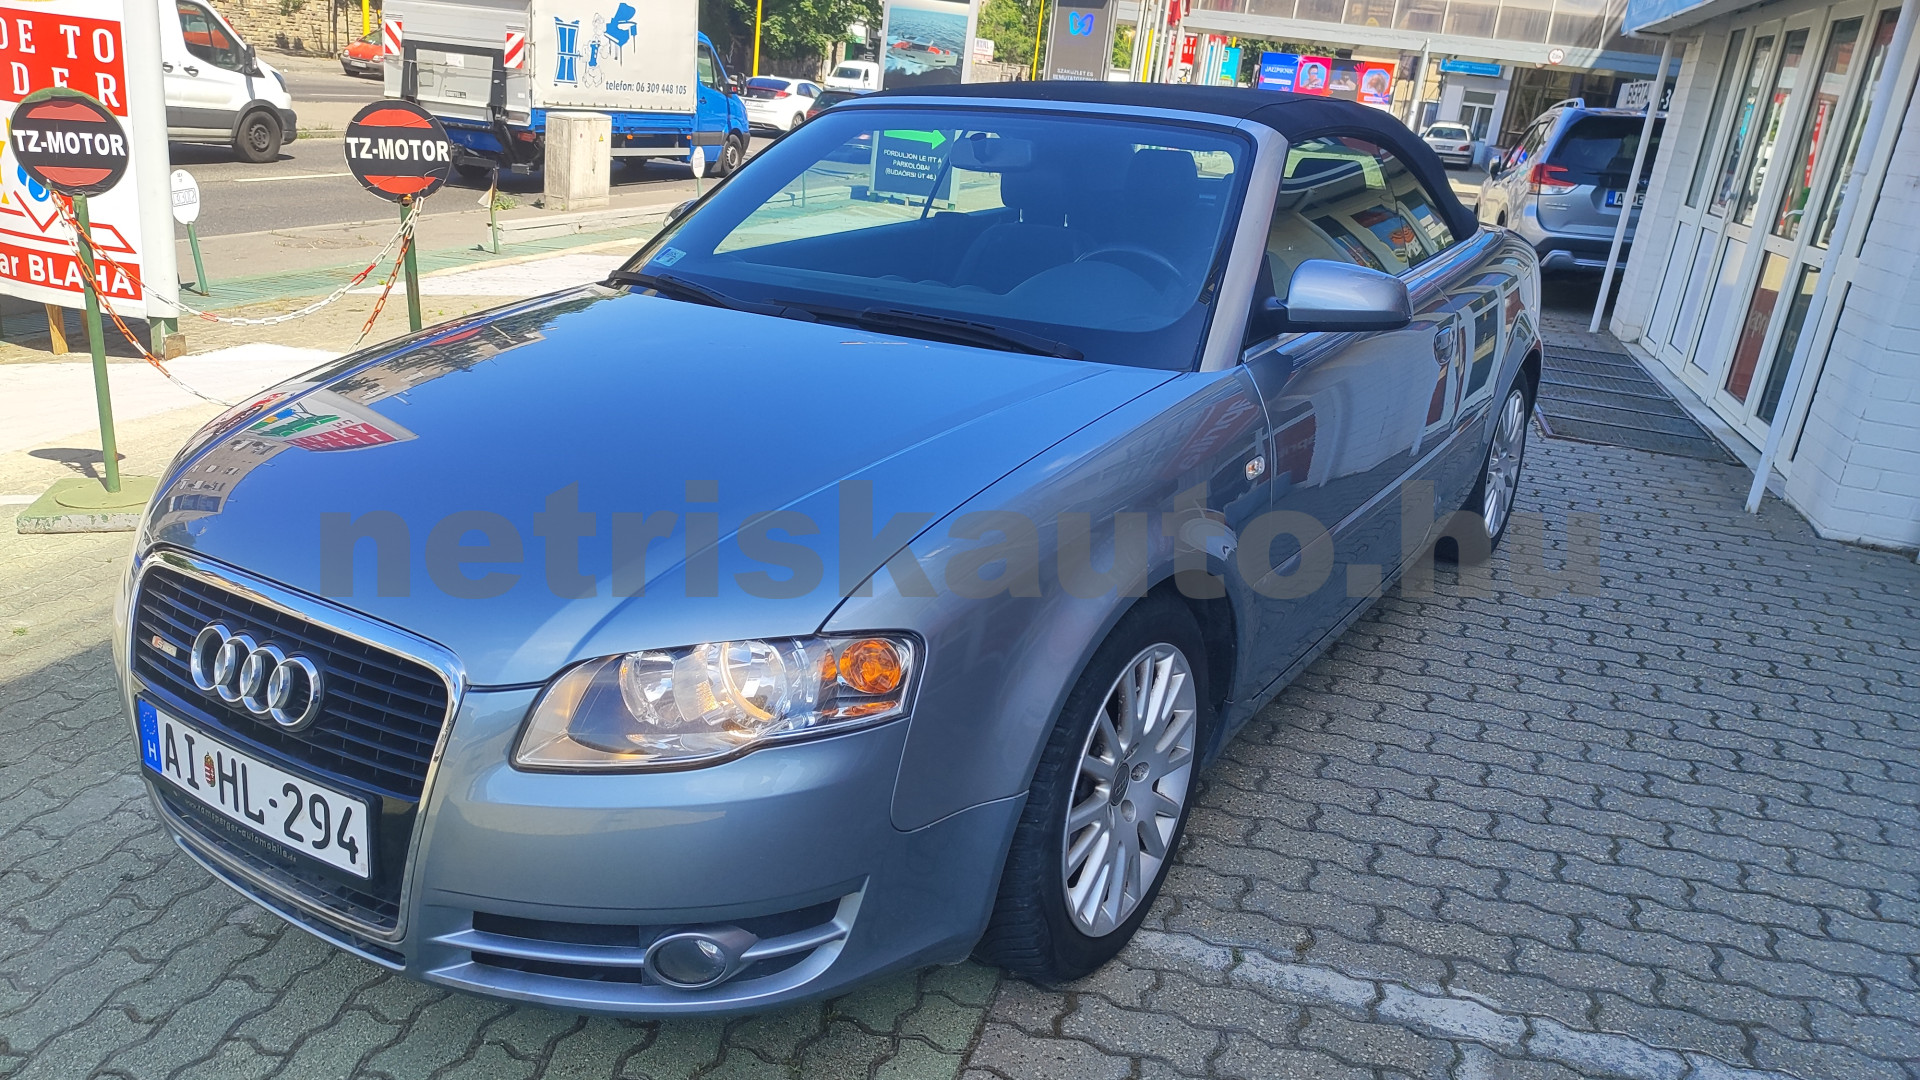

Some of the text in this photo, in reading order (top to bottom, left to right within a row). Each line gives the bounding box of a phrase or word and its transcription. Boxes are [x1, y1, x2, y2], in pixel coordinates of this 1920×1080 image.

[59, 24, 115, 63] TO
[10, 61, 120, 107] DER
[606, 80, 687, 95] telefon: 06 309 448 105
[12, 129, 126, 157] TZ-MOTOR
[346, 137, 450, 161] TZ-MOTOR
[883, 149, 917, 160] FORDULJON
[27, 253, 136, 296] BLAHA
[148, 740, 157, 762] H
[165, 722, 359, 865] AI HL-294
